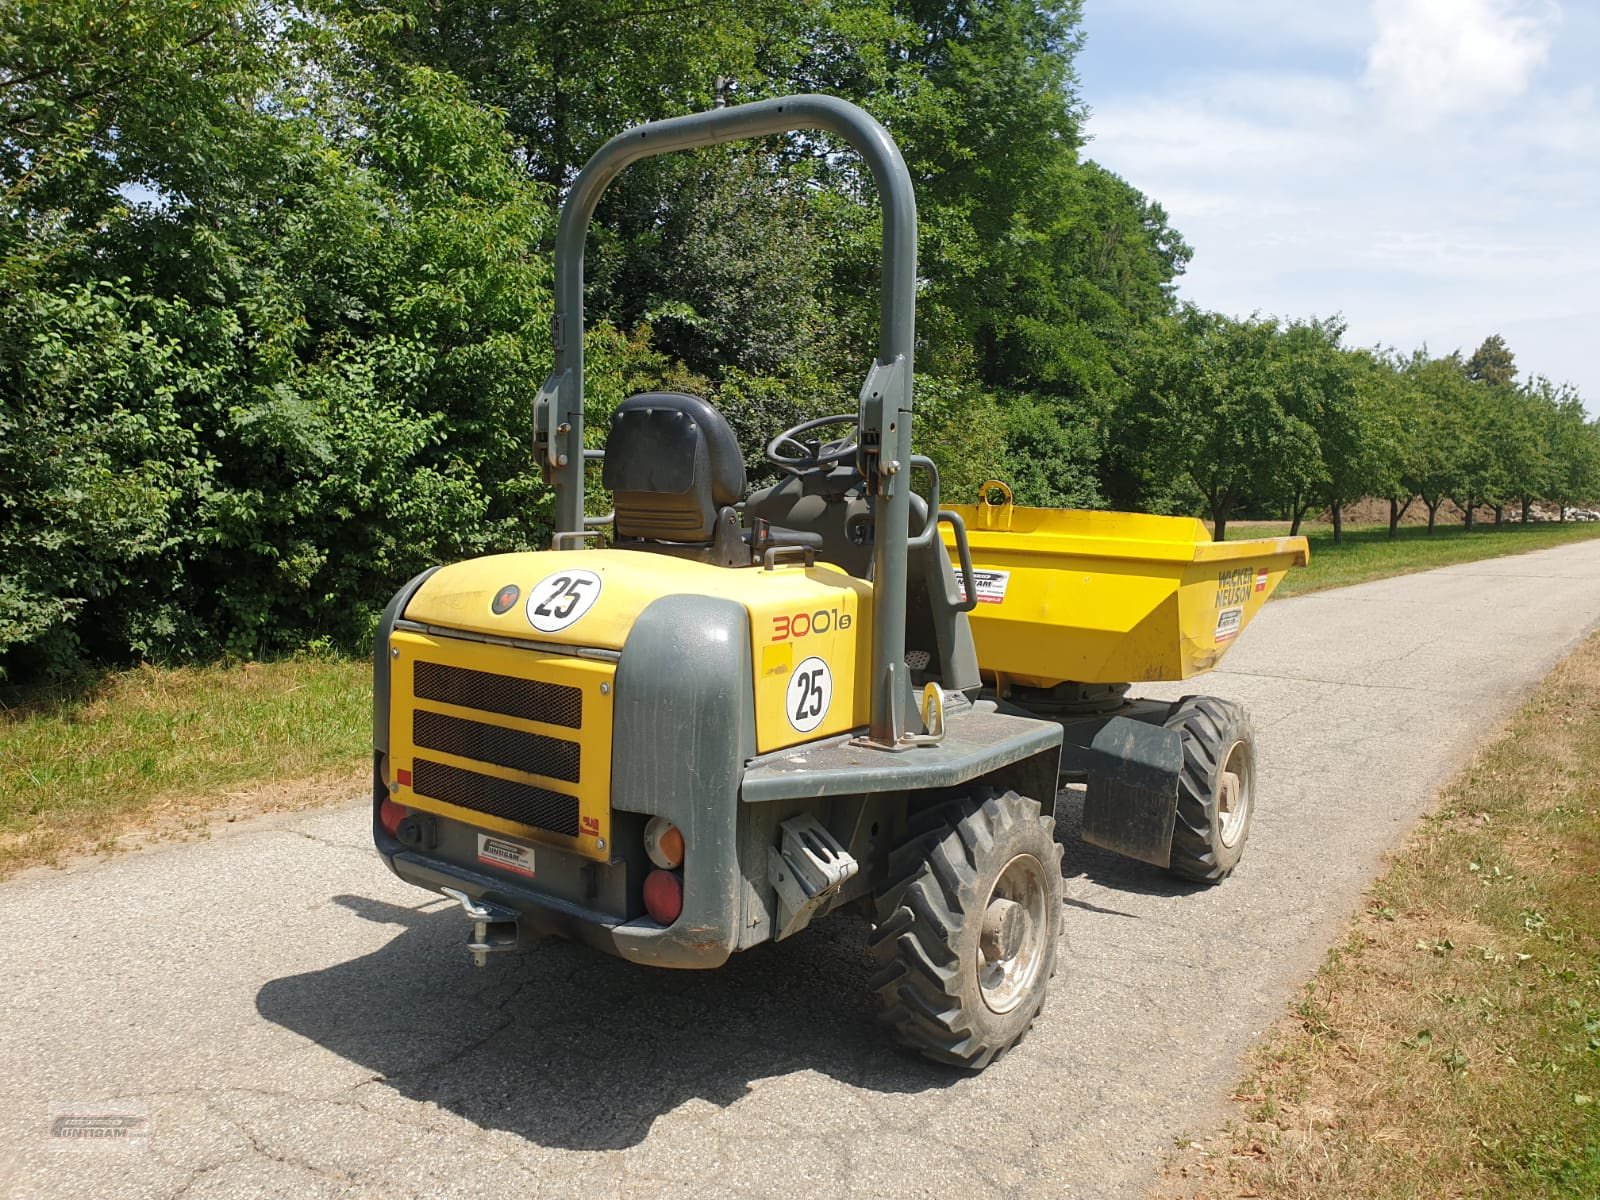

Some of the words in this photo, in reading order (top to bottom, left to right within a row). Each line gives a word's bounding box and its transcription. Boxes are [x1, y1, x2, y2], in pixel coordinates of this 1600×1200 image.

[1219, 567, 1253, 588] WACKER
[534, 577, 593, 619] 25
[1215, 586, 1251, 608] NEUSON
[796, 669, 824, 720] 25
